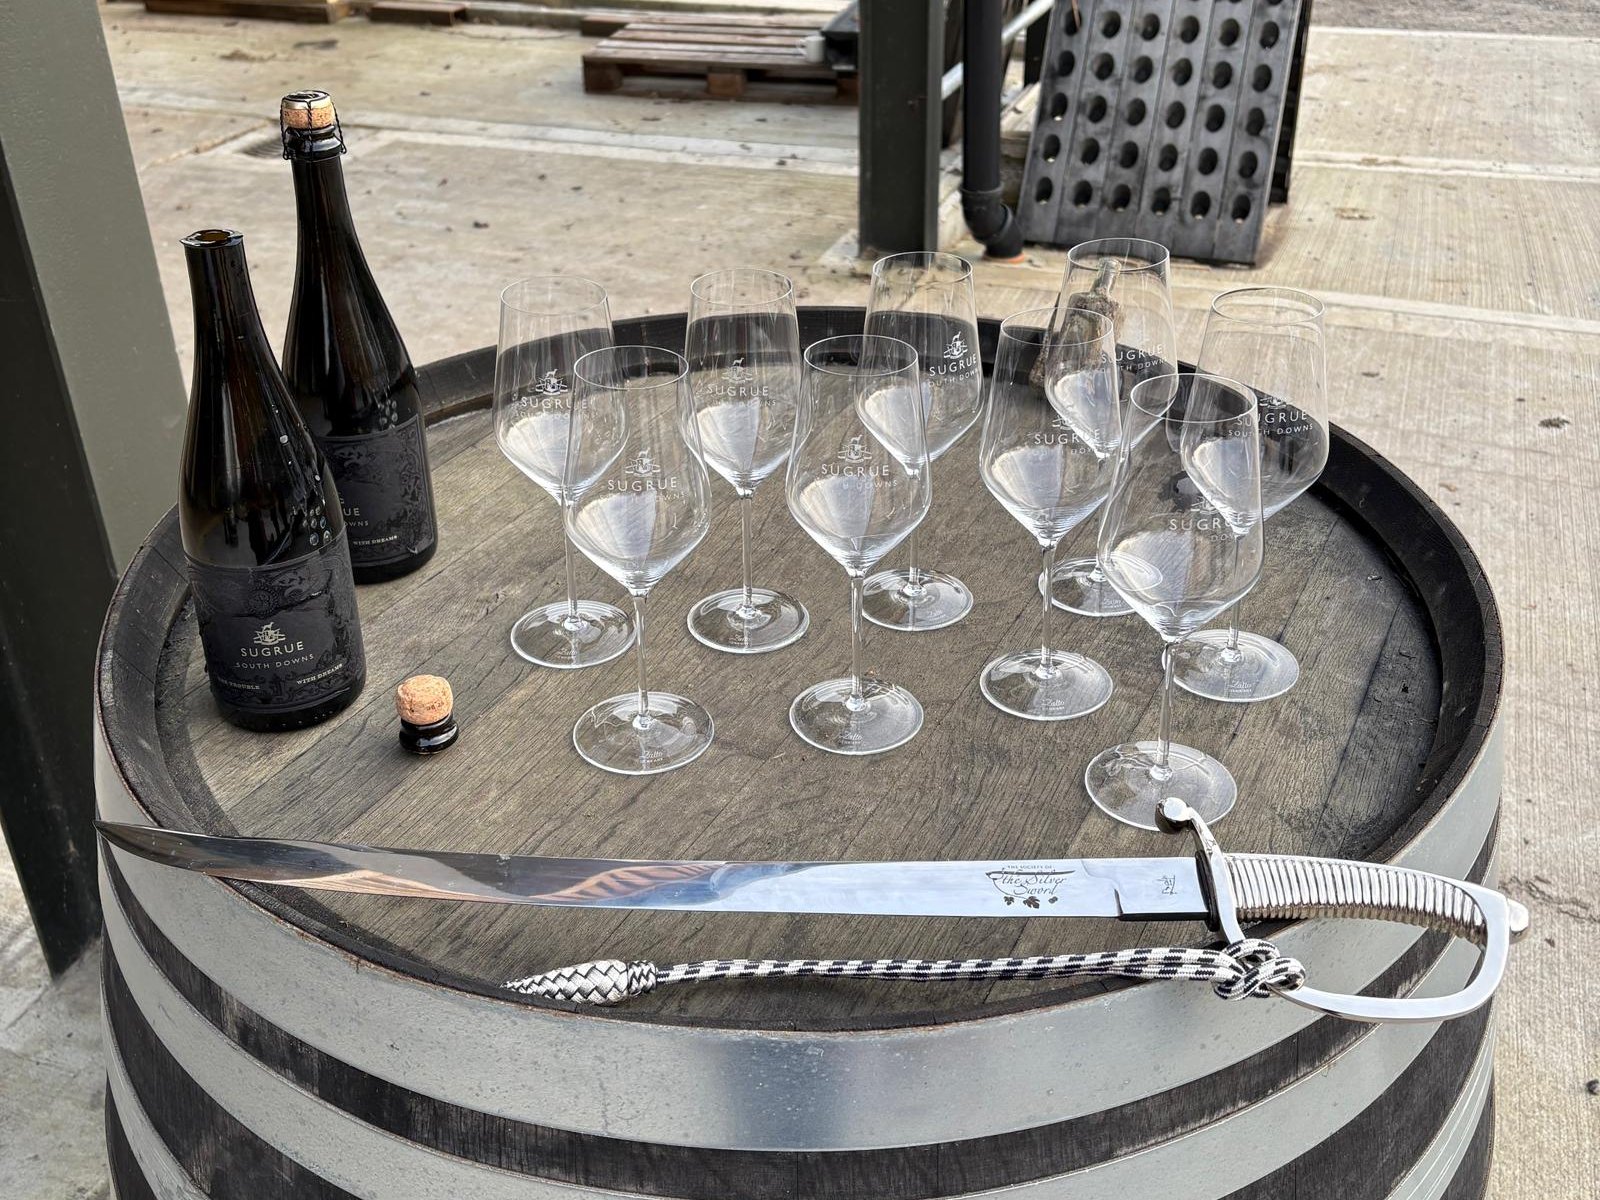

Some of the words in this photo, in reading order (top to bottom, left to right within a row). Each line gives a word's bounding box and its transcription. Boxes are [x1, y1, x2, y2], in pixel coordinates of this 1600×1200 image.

[929, 353, 977, 377] SUGRUE
[706, 385, 769, 397] SUGRUE
[1237, 410, 1308, 427] SUGRUE
[1277, 423, 1313, 435] DOWNS
[820, 463, 890, 478] SUGRUE
[607, 476, 678, 492] SUGRUE
[240, 641, 305, 658] SUGRUE
[235, 661, 270, 669] SOUTH
[275, 653, 314, 668] DOWNS
[296, 674, 317, 685] WITH
[1013, 883, 1059, 895] Sword
